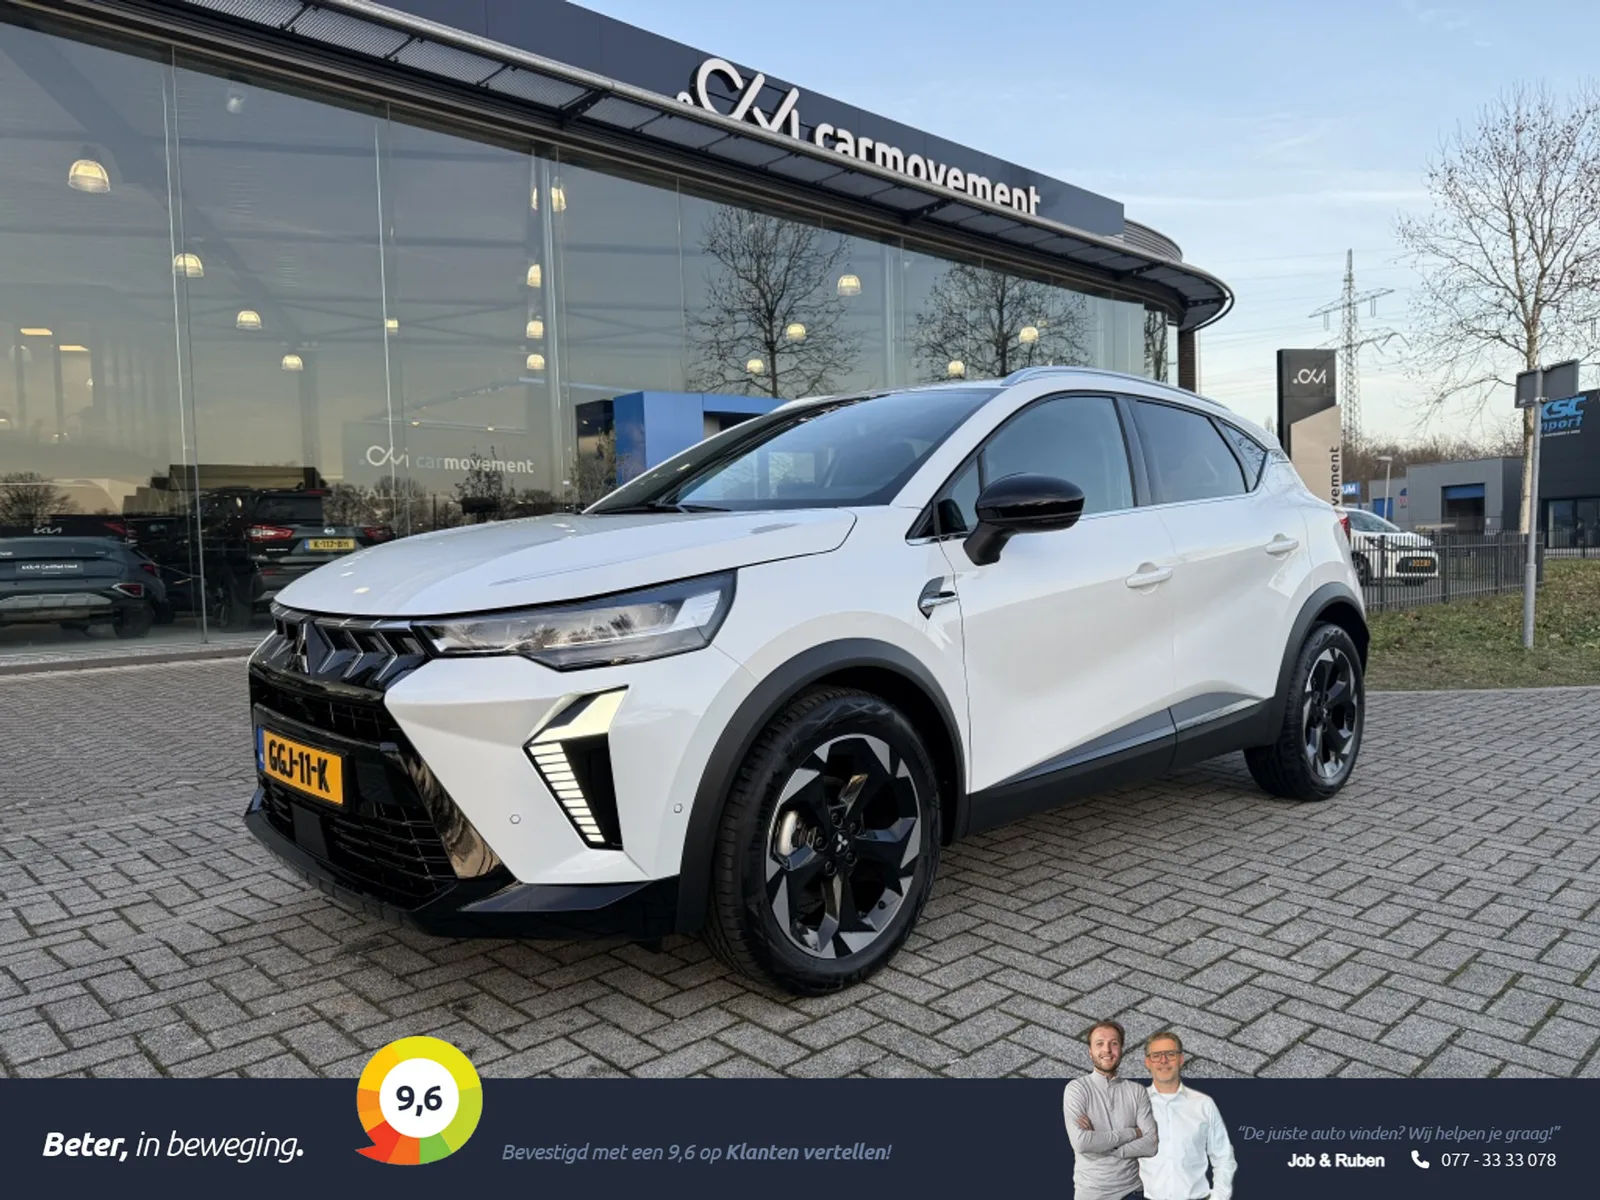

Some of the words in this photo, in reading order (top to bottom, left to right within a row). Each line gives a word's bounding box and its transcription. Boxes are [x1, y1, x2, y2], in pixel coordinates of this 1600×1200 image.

[815, 123, 1041, 216] carmovement
[415, 455, 535, 474] carmovement
[268, 739, 331, 793] GGJ-11-K
